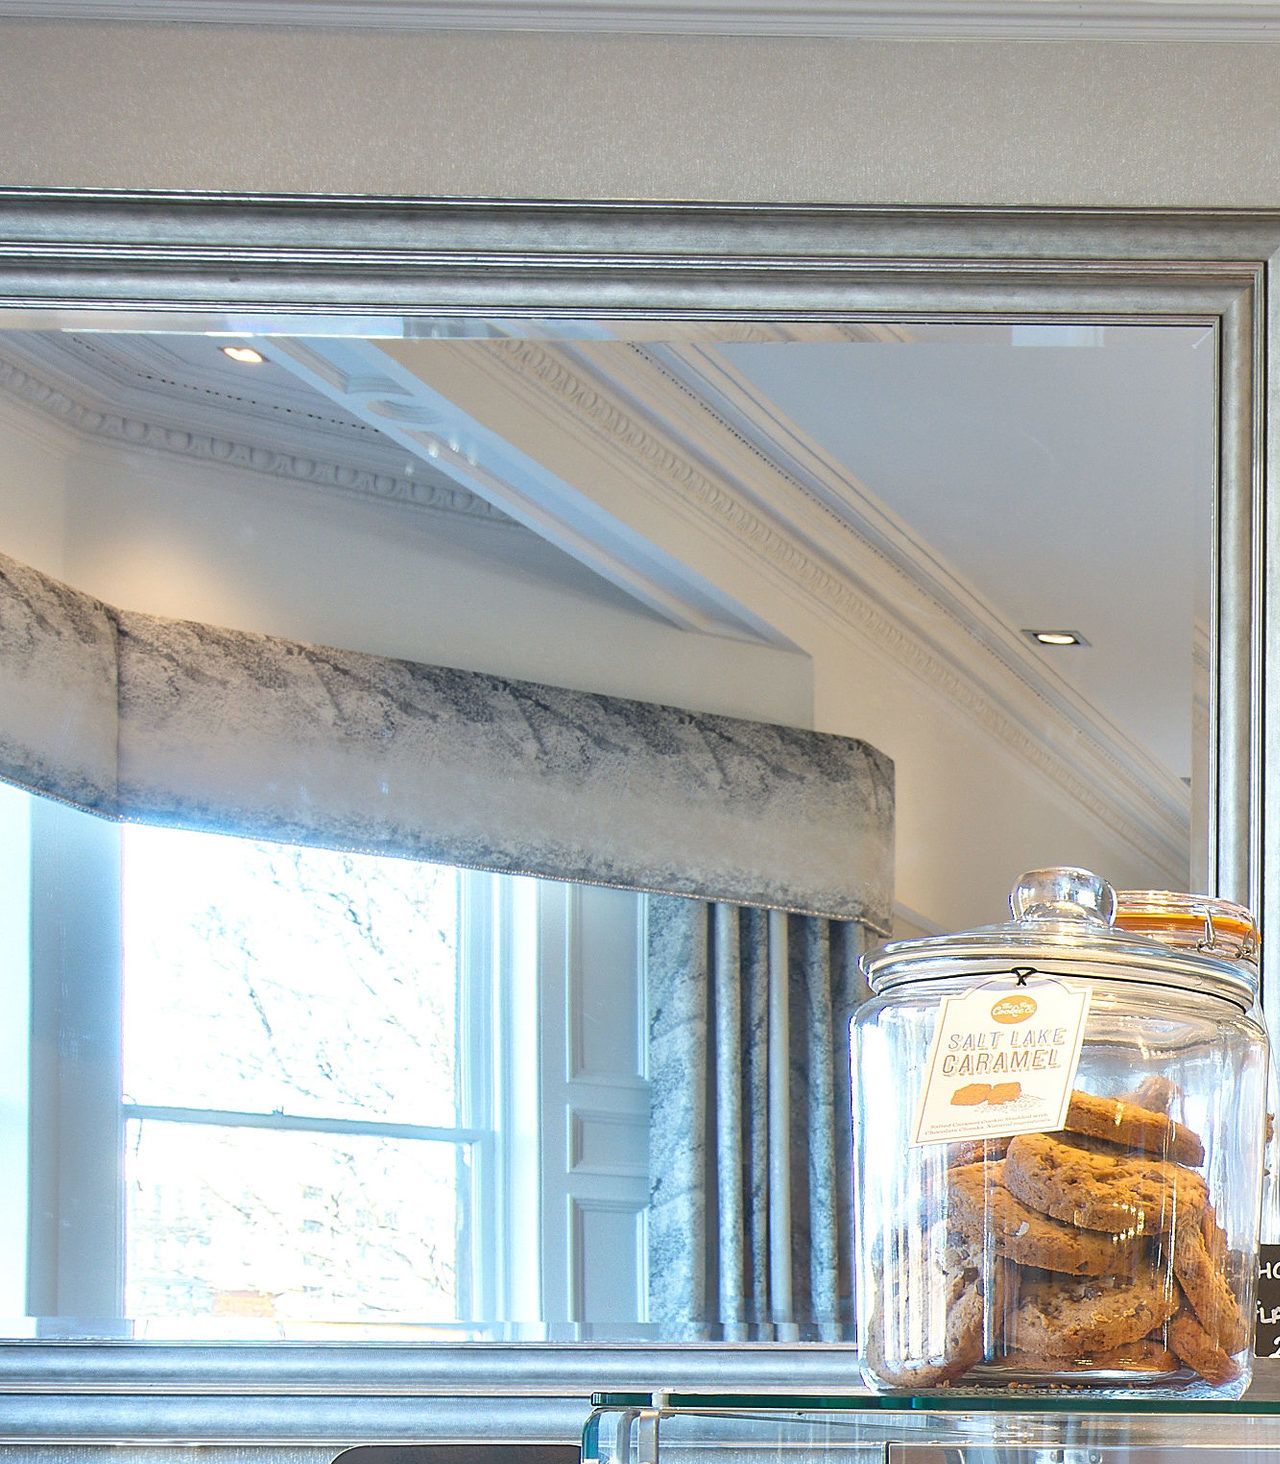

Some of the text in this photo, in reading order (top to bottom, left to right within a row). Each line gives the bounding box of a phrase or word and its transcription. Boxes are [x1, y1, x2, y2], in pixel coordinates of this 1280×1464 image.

[948, 1027, 1067, 1051] SALT LAKE
[942, 1048, 1062, 1077] CARAMEL
